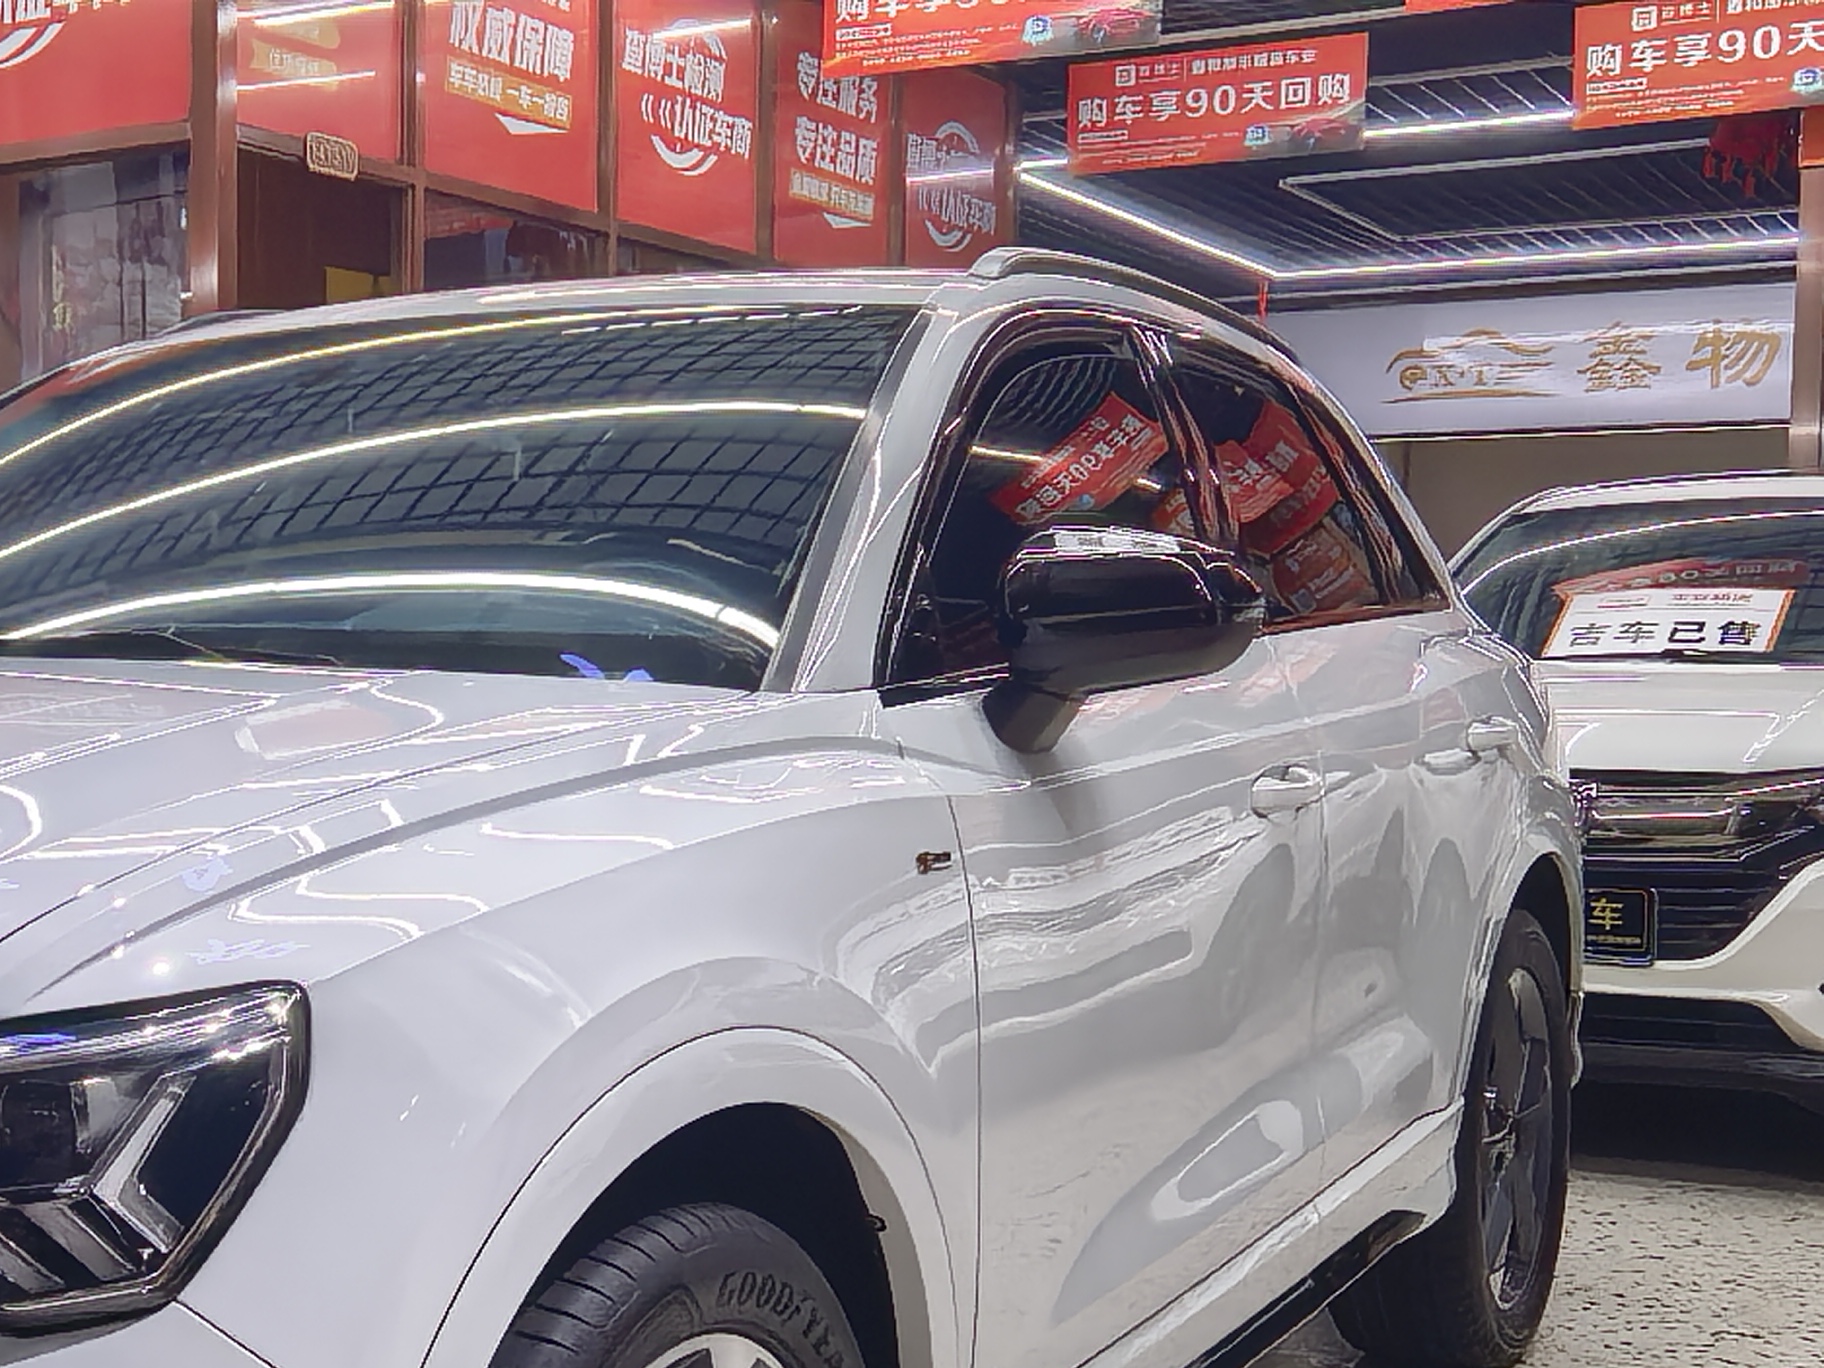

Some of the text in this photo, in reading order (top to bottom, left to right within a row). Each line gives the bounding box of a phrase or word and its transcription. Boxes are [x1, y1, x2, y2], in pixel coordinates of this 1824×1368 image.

[1587, 20, 1824, 79] 购车享90天
[1078, 73, 1350, 128] 购车享90天回购
